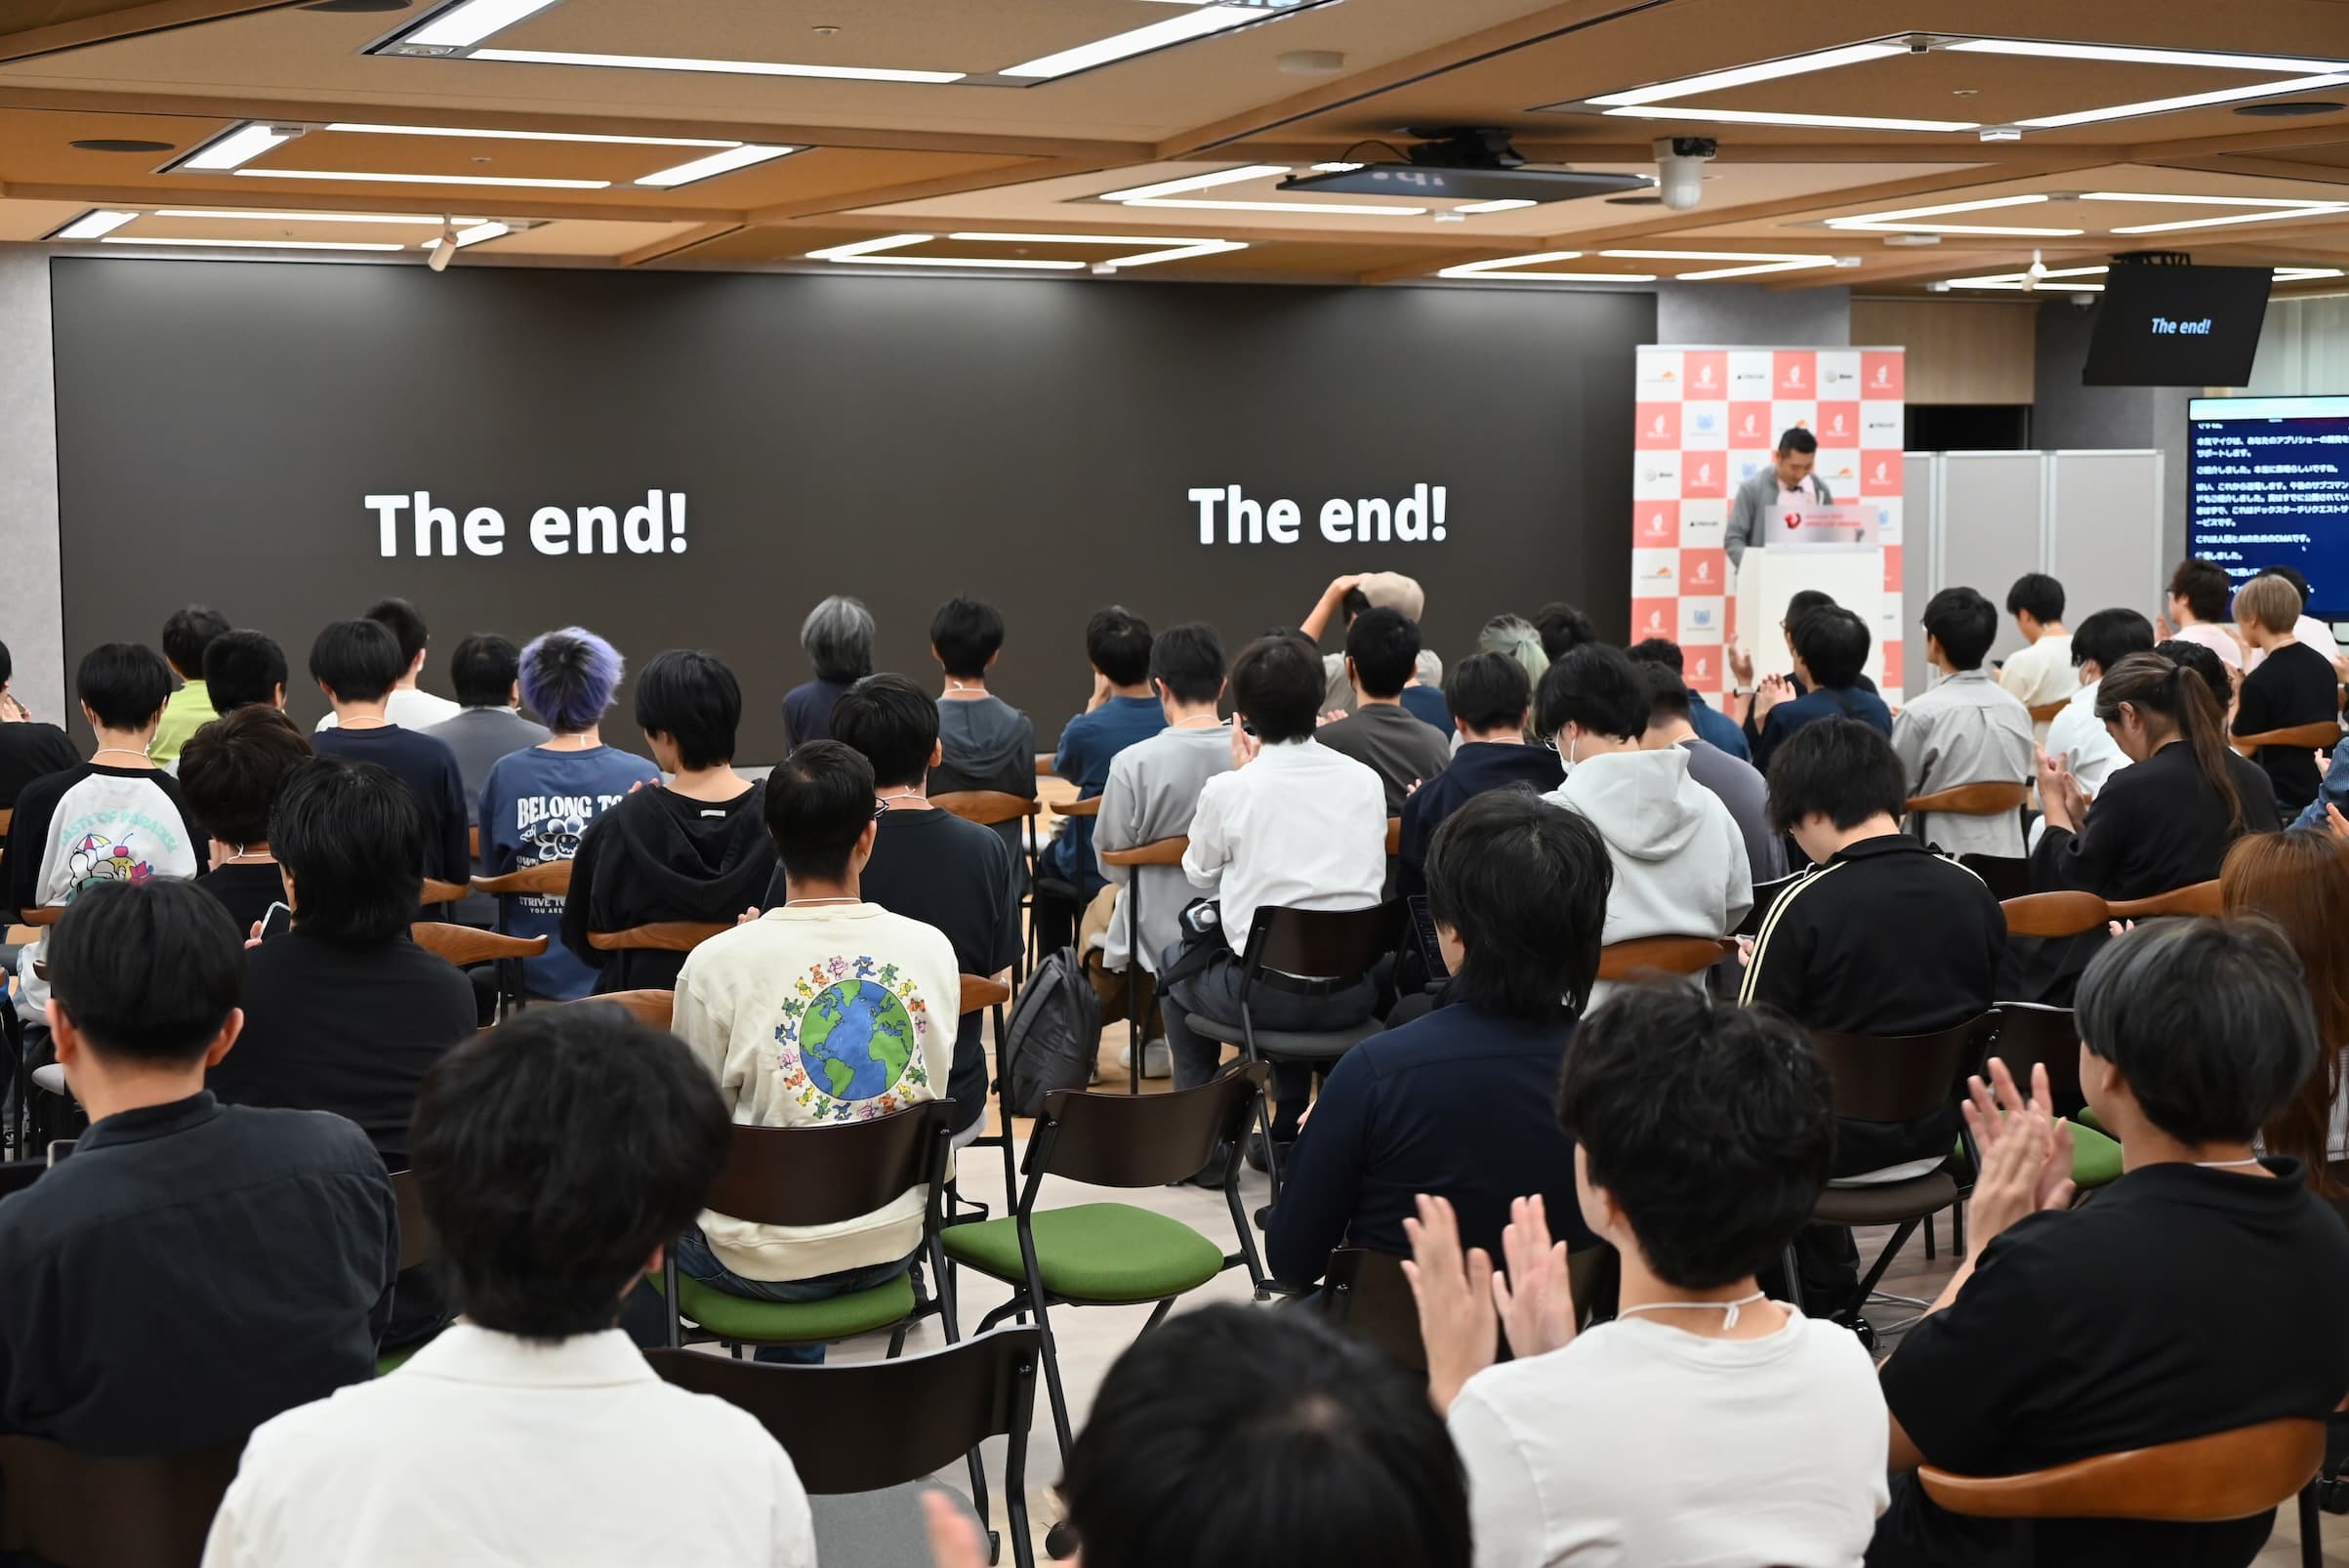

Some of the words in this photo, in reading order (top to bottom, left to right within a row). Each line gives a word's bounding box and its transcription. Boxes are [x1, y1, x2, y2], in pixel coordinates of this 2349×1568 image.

[2151, 316, 2177, 334] The
[2179, 317, 2212, 335] end!
[364, 490, 506, 557] The
[529, 489, 687, 556] end!
[1187, 484, 1301, 545] The
[1319, 482, 1447, 543] end!
[516, 796, 593, 830] BELONG
